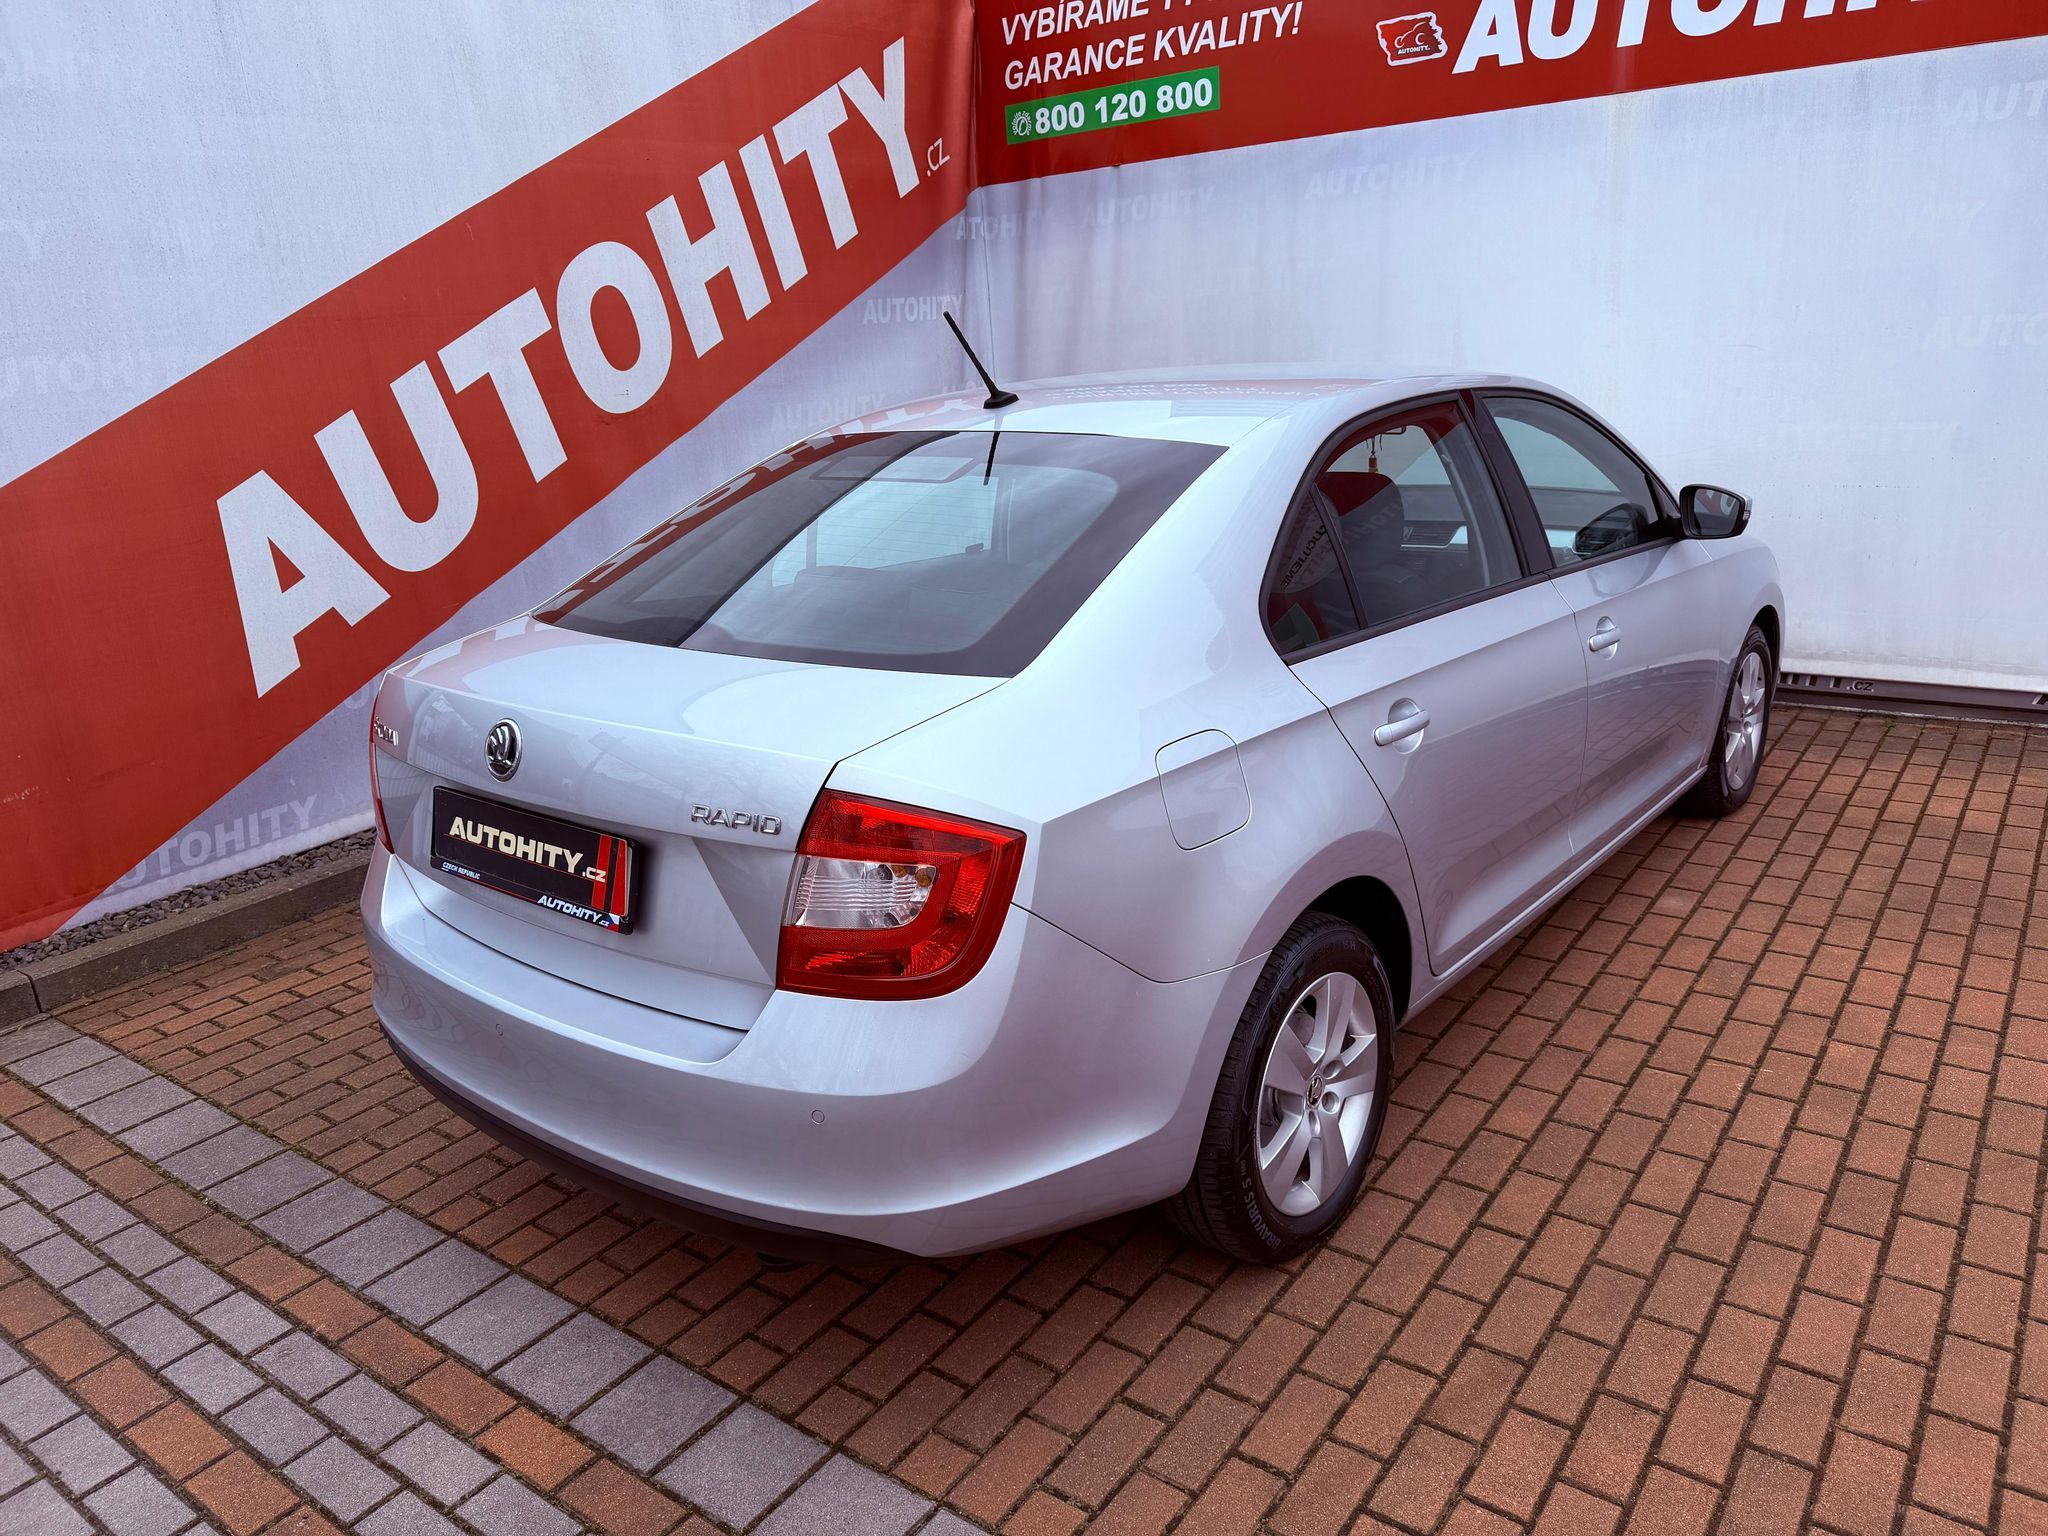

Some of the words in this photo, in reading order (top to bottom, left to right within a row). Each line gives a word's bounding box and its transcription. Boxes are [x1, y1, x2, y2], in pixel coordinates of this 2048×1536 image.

[1004, 33, 1146, 90] GARANCE
[1153, 1, 1303, 62] KVALITY!
[1034, 101, 1085, 135] 800
[1094, 90, 1147, 124] 120
[1156, 78, 1213, 114] 800
[690, 803, 782, 835] RAPID
